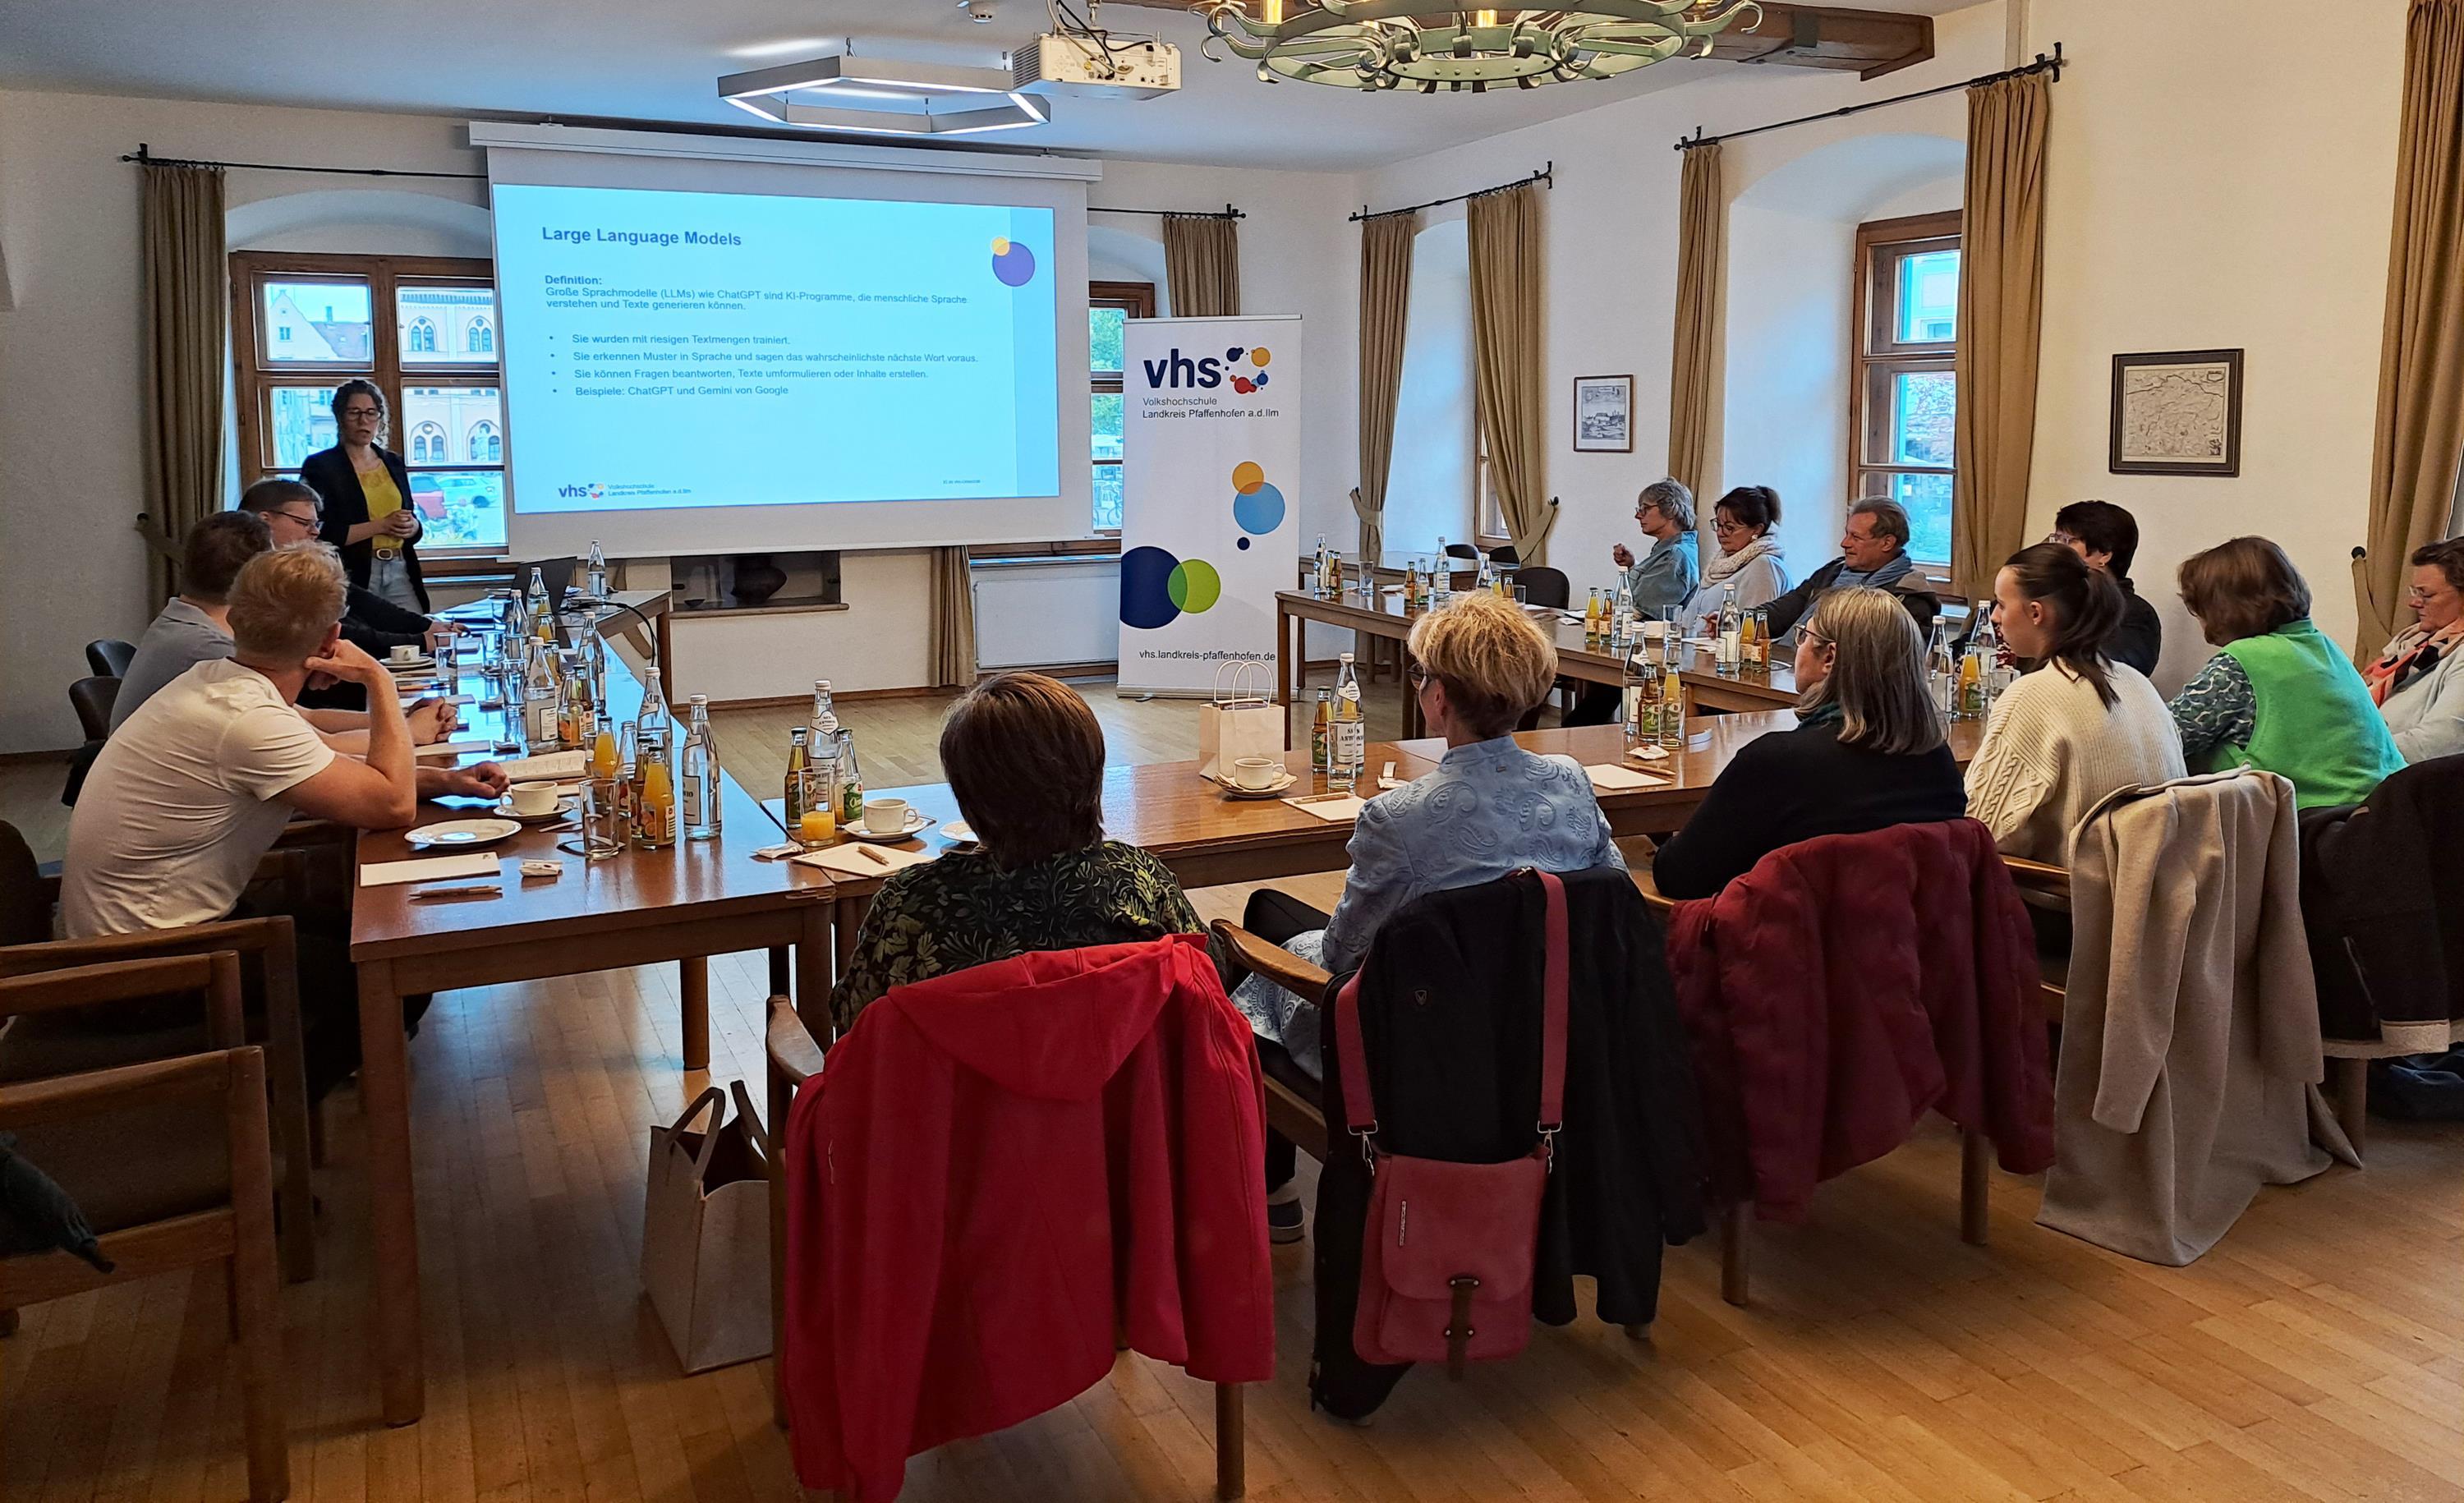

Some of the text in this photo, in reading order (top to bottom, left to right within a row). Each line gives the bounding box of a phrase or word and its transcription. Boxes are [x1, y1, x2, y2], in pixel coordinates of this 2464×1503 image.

[543, 227, 741, 246] Large Language Models
[545, 275, 602, 284] Definition:
[546, 287, 579, 296] Große
[582, 288, 657, 299] Sprachmodelle
[660, 289, 695, 300] (LLMs)
[717, 290, 761, 300] ChatGPT
[764, 292, 783, 300] sind
[786, 292, 855, 302] KI-Programme,
[874, 294, 929, 302] menschliche
[931, 295, 967, 304] Sprache
[546, 300, 745, 310] verstehen und Texte generieren können.
[572, 334, 589, 342] Sie
[592, 335, 629, 343] wurden
[632, 335, 647, 343] mit
[650, 335, 689, 345] riesigen
[753, 336, 791, 345] trainiert.
[573, 352, 590, 361] Sie
[593, 352, 640, 361] erkennen
[644, 352, 677, 361] Muster
[680, 352, 688, 361] in
[692, 352, 732, 362] Sprache
[735, 352, 752, 361] und
[756, 354, 784, 362] sagen
[806, 353, 885, 361] wahrscheinlichste
[1143, 348, 1221, 388] vhs
[575, 369, 928, 379] Sie können Fragen beantworten, Texte umformulieren oder Inhalte erstellen.
[576, 387, 625, 398] Beispiele:
[627, 387, 673, 395] ChatGPT
[698, 386, 732, 394] Gemini
[755, 386, 788, 396] Google
[1143, 397, 1217, 406] Volkshochschule
[1143, 410, 1185, 418] Landkreis
[1189, 409, 1245, 417] Pfaffenhofen
[559, 485, 587, 498] vhs
[1139, 650, 1276, 661] vhs.landkreis-pfaffenhofen.de
